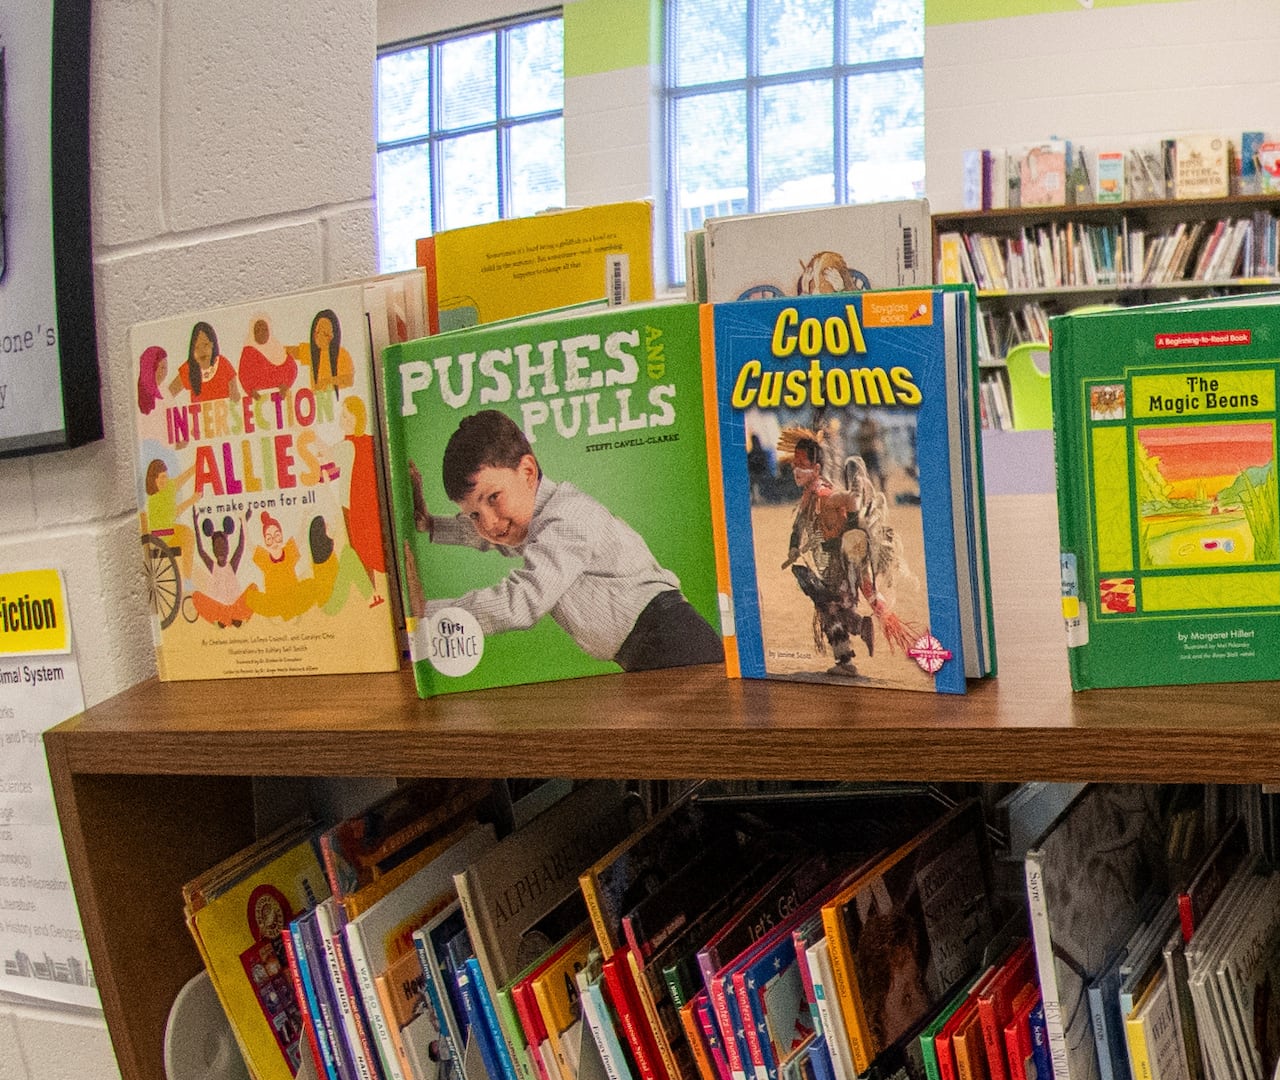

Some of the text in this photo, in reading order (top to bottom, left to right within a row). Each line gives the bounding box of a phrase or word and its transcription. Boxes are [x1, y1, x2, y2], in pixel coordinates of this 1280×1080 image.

[0, 324, 56, 353] one's
[771, 304, 867, 357] Cool
[1166, 335, 1228, 345] Beginning-to-Read
[646, 326, 666, 380] AND
[400, 329, 640, 416] PUSHES
[732, 360, 923, 409] Customs
[1187, 377, 1218, 392] The
[521, 384, 676, 443] PULLS
[1149, 393, 1258, 413] Magic Beans
[166, 388, 334, 444] INTERSECTION
[586, 434, 680, 453] STEFFI CAVELL-CLARKE
[195, 431, 321, 496] ALLIES
[199, 491, 316, 514] we make room for all
[0, 594, 57, 633] iction
[441, 622, 464, 634] First
[1178, 630, 1254, 642] by Margaret Hillert
[432, 636, 478, 658] SCIENCE
[768, 651, 777, 659] by
[796, 652, 811, 660] Scott
[23, 665, 64, 686] System
